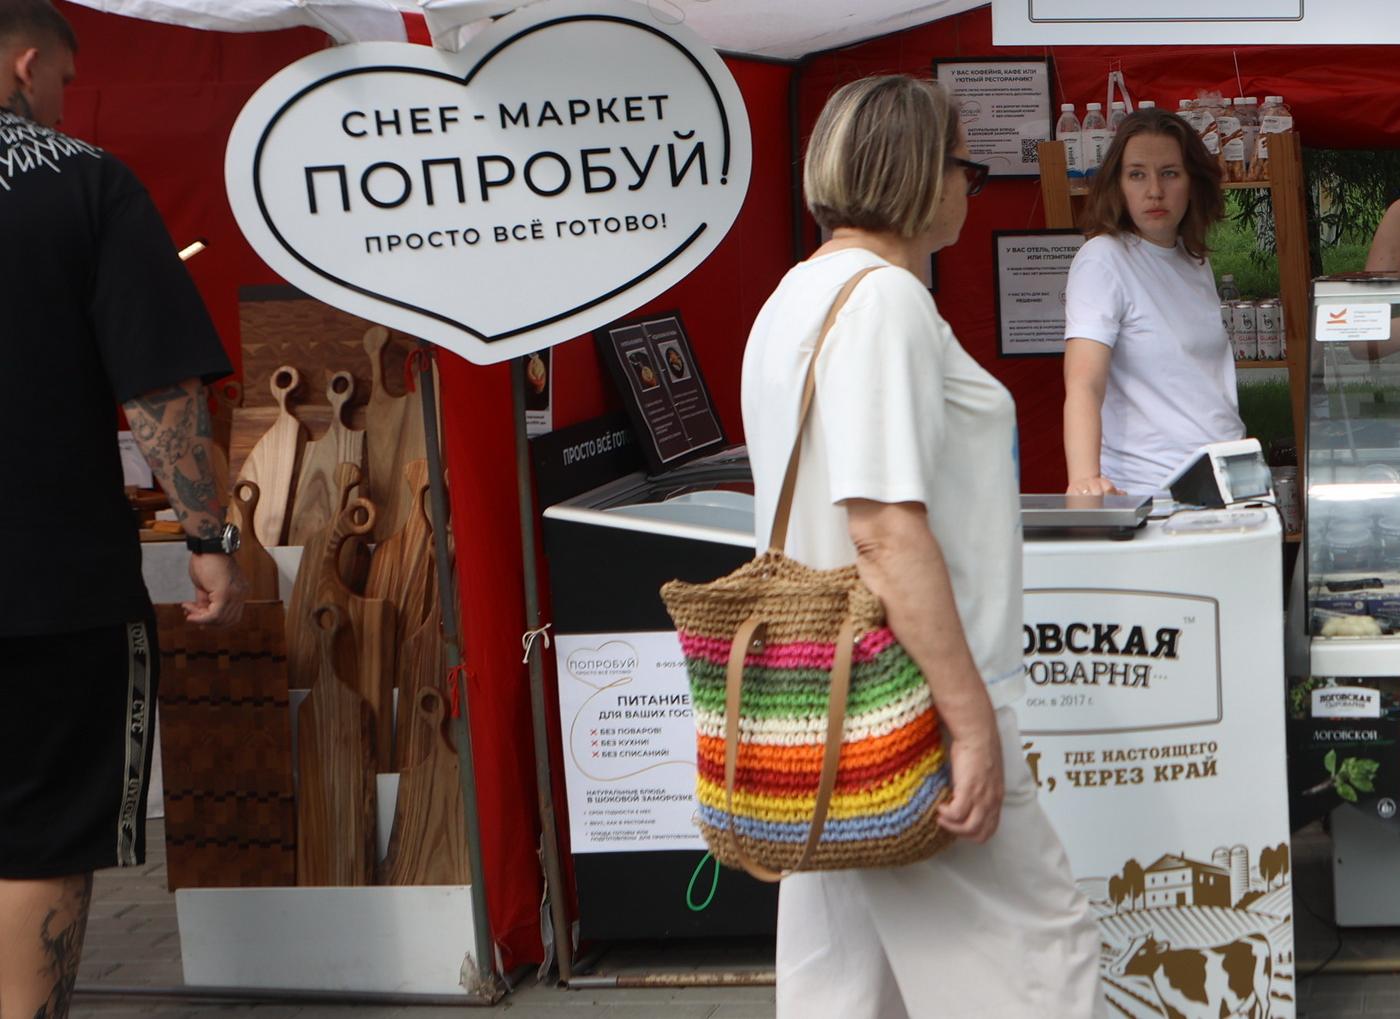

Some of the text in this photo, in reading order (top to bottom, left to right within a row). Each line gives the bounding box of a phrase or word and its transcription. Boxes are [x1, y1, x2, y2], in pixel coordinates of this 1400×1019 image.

[341, 106, 461, 138] CHEF
[499, 95, 669, 129] МАРКЕТ
[365, 213, 667, 253] ПРОСТО ВСЁ ГОТОВО!
[563, 440, 596, 466] ПРОСТО
[597, 431, 613, 454] ВСЁ
[1024, 661, 1152, 688] ОВАРНЯ
[617, 694, 690, 706] ПИТАНИЕ
[1060, 696, 1086, 706] 2017
[599, 711, 622, 720] ДЛЯ
[625, 710, 665, 719] ВАШИХ
[601, 739, 617, 747] БЕЗ
[601, 750, 617, 758] БЕЗ
[1064, 742, 1218, 766] ГДЕ НАСТОЯЩЕГО
[1065, 756, 1218, 788] ЧЕРЕЗ КРАЙ
